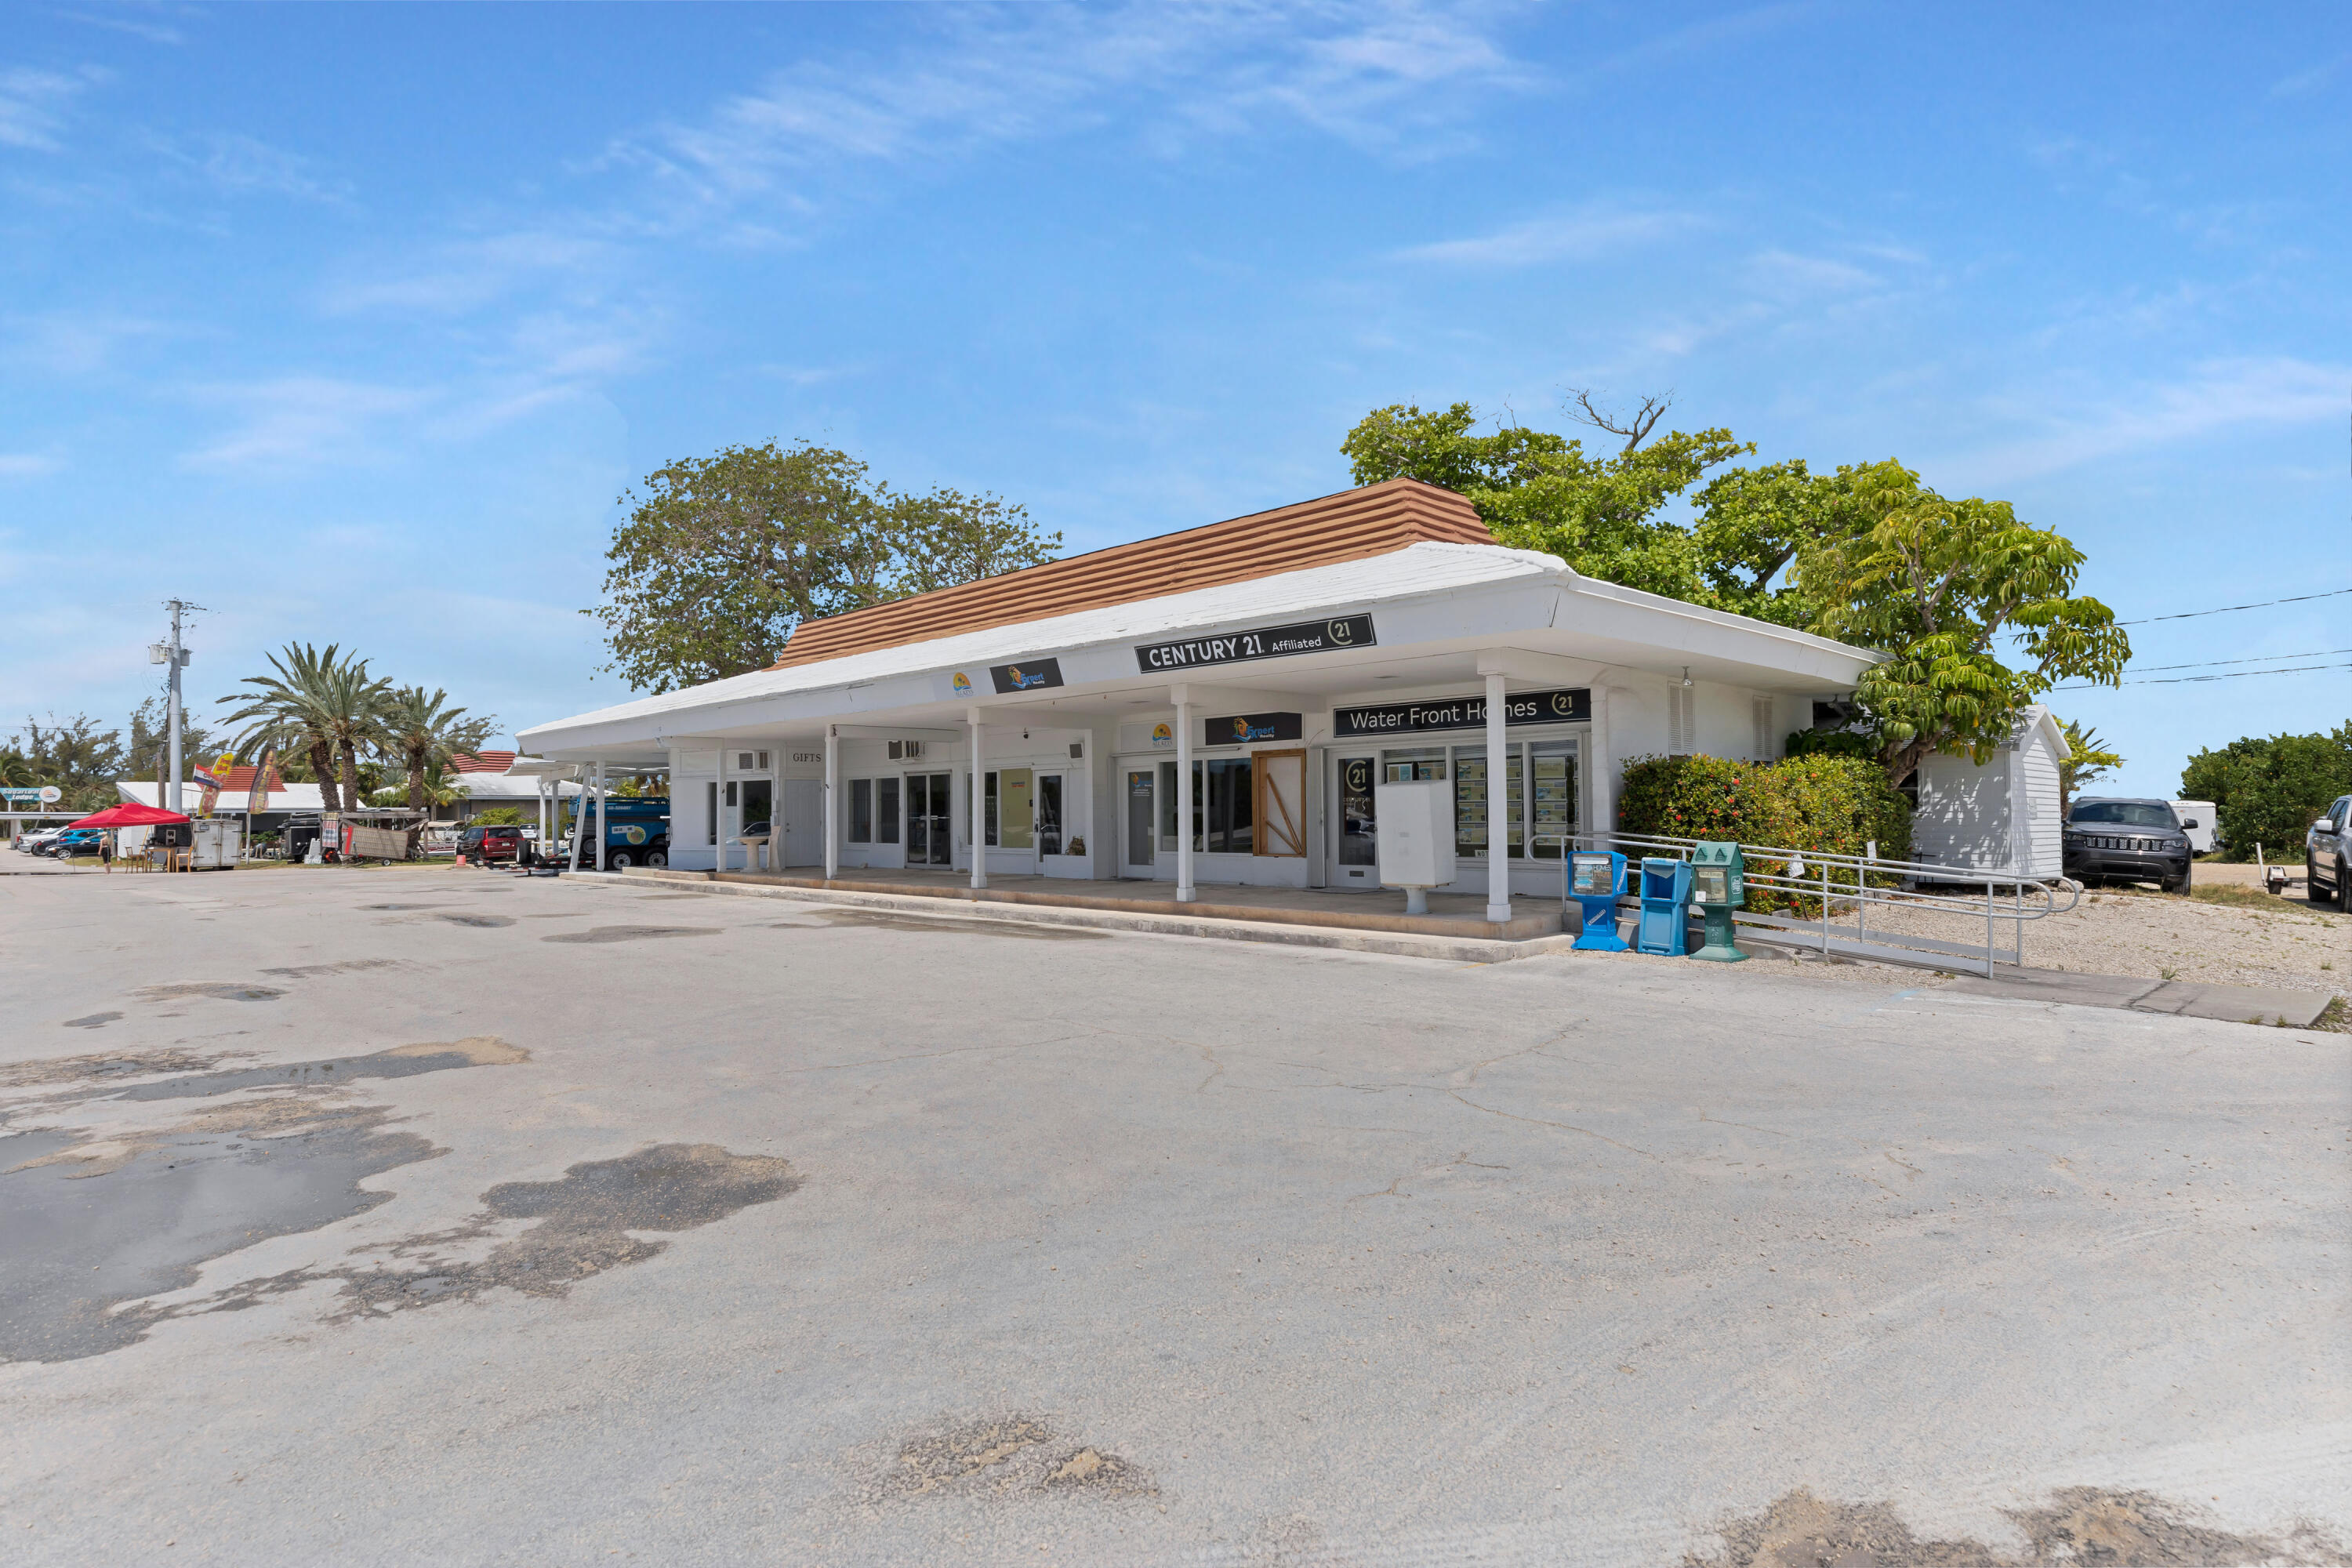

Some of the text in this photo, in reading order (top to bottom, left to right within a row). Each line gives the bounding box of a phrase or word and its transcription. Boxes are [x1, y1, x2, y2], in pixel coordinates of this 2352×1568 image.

[1149, 634, 1322, 666] CENTURY 21 Affiliated
[1350, 711, 1404, 728] Water
[1410, 706, 1461, 724] Front
[793, 753, 822, 762] GIFTS
